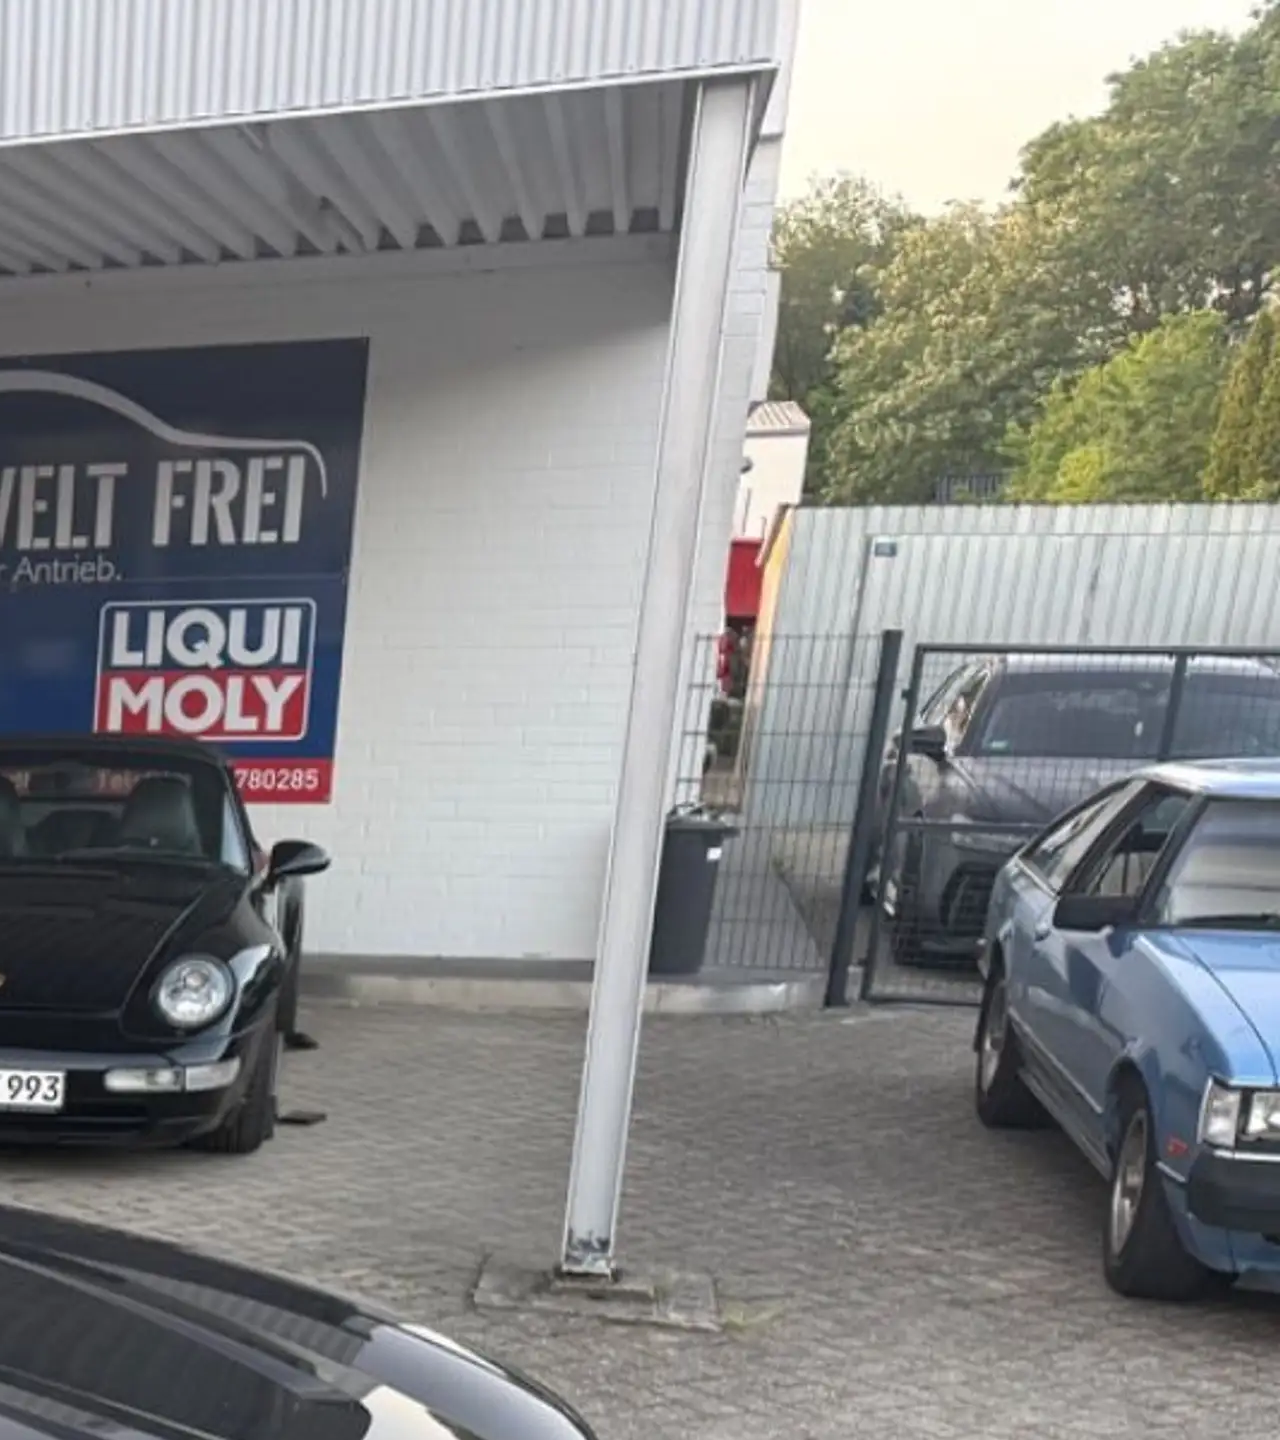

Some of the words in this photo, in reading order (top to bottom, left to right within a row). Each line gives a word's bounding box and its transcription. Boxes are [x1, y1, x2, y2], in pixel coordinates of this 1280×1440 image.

[152, 455, 306, 547] FREI
[12, 553, 123, 586] Antrieb.
[110, 607, 302, 670] LIQUI
[107, 674, 304, 733] MOLY
[7, 1075, 61, 1102] 993
